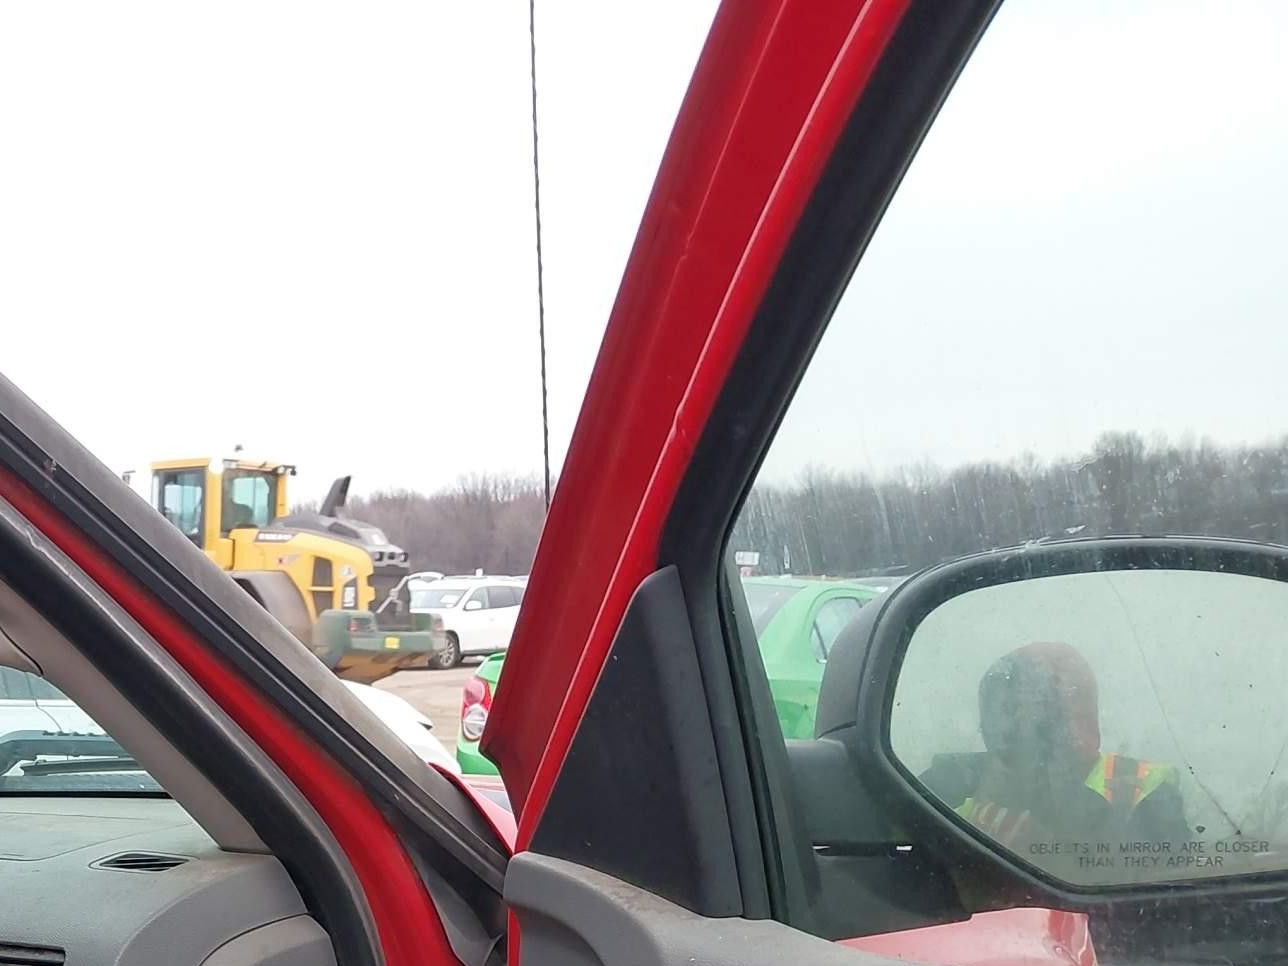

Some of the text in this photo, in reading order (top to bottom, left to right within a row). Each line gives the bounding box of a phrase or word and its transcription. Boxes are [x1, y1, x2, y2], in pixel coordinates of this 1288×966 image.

[1029, 841, 1270, 855] OBJETS IN MIRROR ARE CLOSER
[1078, 855, 1224, 868] THAN THEY APPEAR
